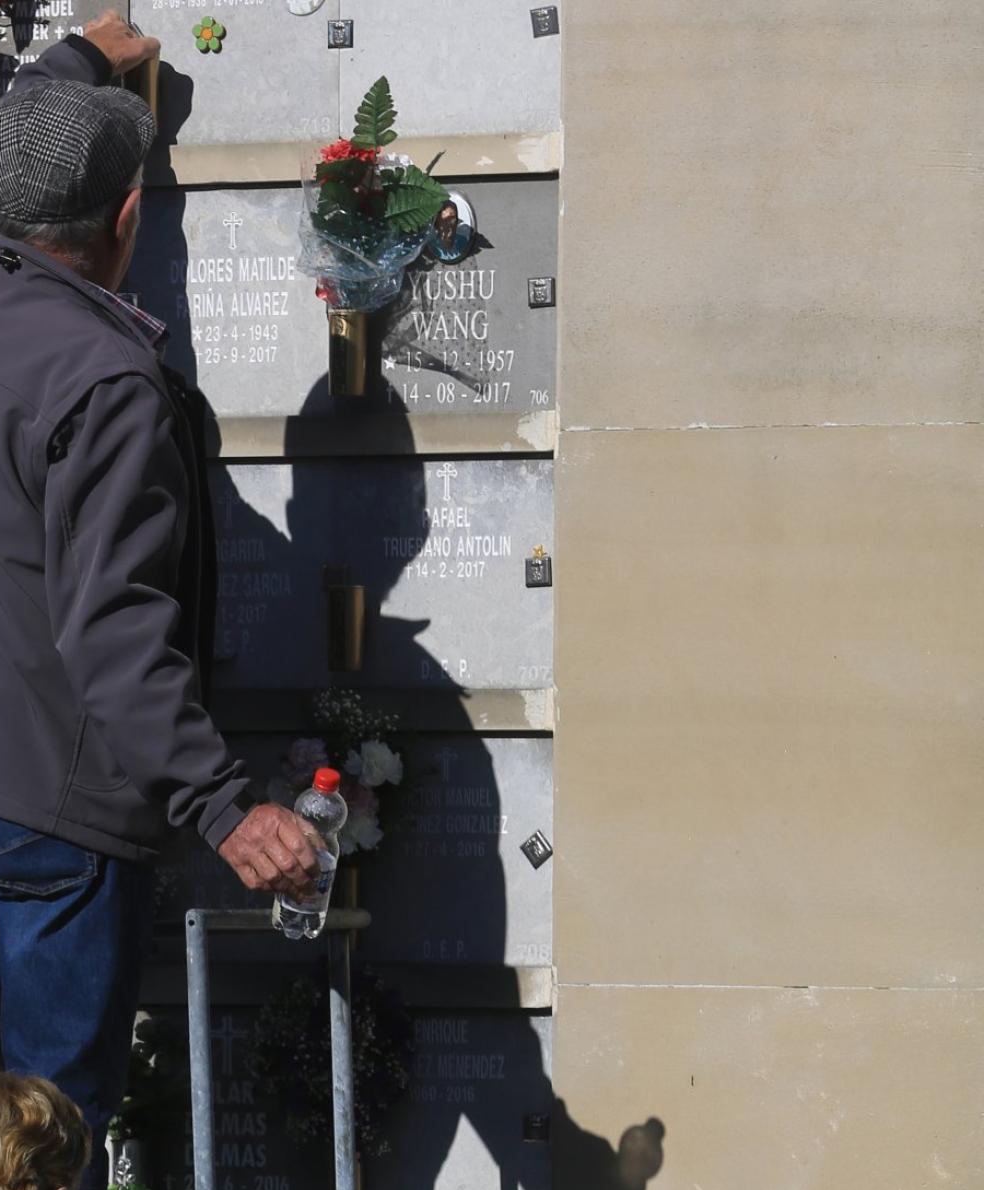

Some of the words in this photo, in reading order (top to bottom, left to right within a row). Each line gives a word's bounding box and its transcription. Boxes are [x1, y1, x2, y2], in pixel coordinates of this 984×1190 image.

[239, 256, 295, 281] MATILDE
[408, 269, 496, 301] YUSHU
[230, 292, 288, 317] ALVAREZ
[205, 326, 220, 341] 23
[249, 324, 278, 341] 1943
[411, 310, 489, 340] WANG
[205, 348, 220, 363] 25
[249, 346, 277, 362] 2017
[406, 350, 422, 372] 15
[443, 350, 459, 372] 12
[479, 350, 515, 372] 1957
[402, 383, 418, 404] 14
[436, 382, 455, 403] 08
[473, 382, 510, 404] 2017
[529, 390, 549, 405] 706
[423, 507, 470, 528] RAFAEL
[456, 536, 511, 556] ANTOLIN
[416, 562, 428, 577] 14
[457, 561, 485, 577] 2017
